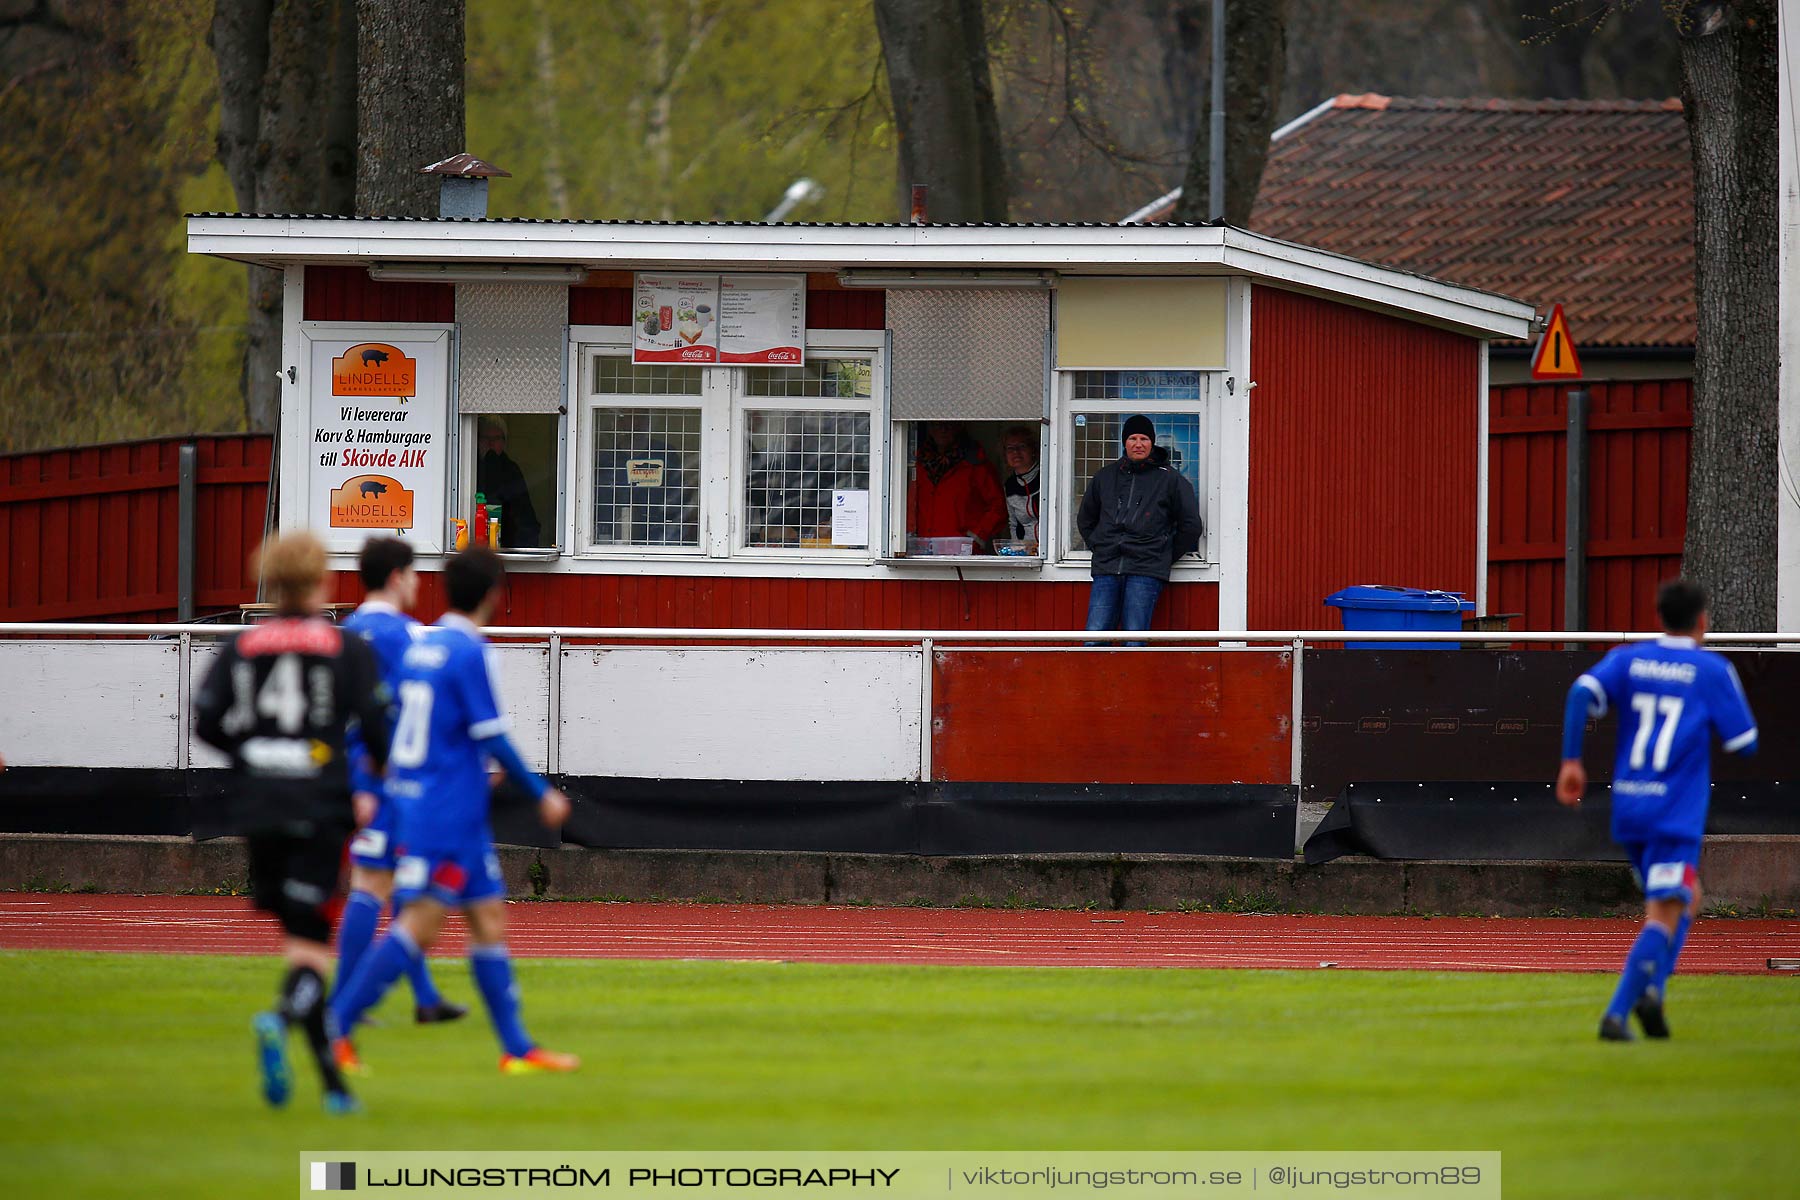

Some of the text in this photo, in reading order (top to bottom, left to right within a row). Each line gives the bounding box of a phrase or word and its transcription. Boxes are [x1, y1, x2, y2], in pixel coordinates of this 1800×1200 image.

[339, 373, 409, 385] LINDELLS
[1126, 375, 1201, 387] POWERAD
[341, 407, 408, 422] Vi levererar
[315, 428, 432, 447] Korv & Hamburgare
[320, 448, 427, 467] till Skövde AIK
[337, 505, 407, 517] LINDELLS
[1629, 692, 1685, 772] 11
